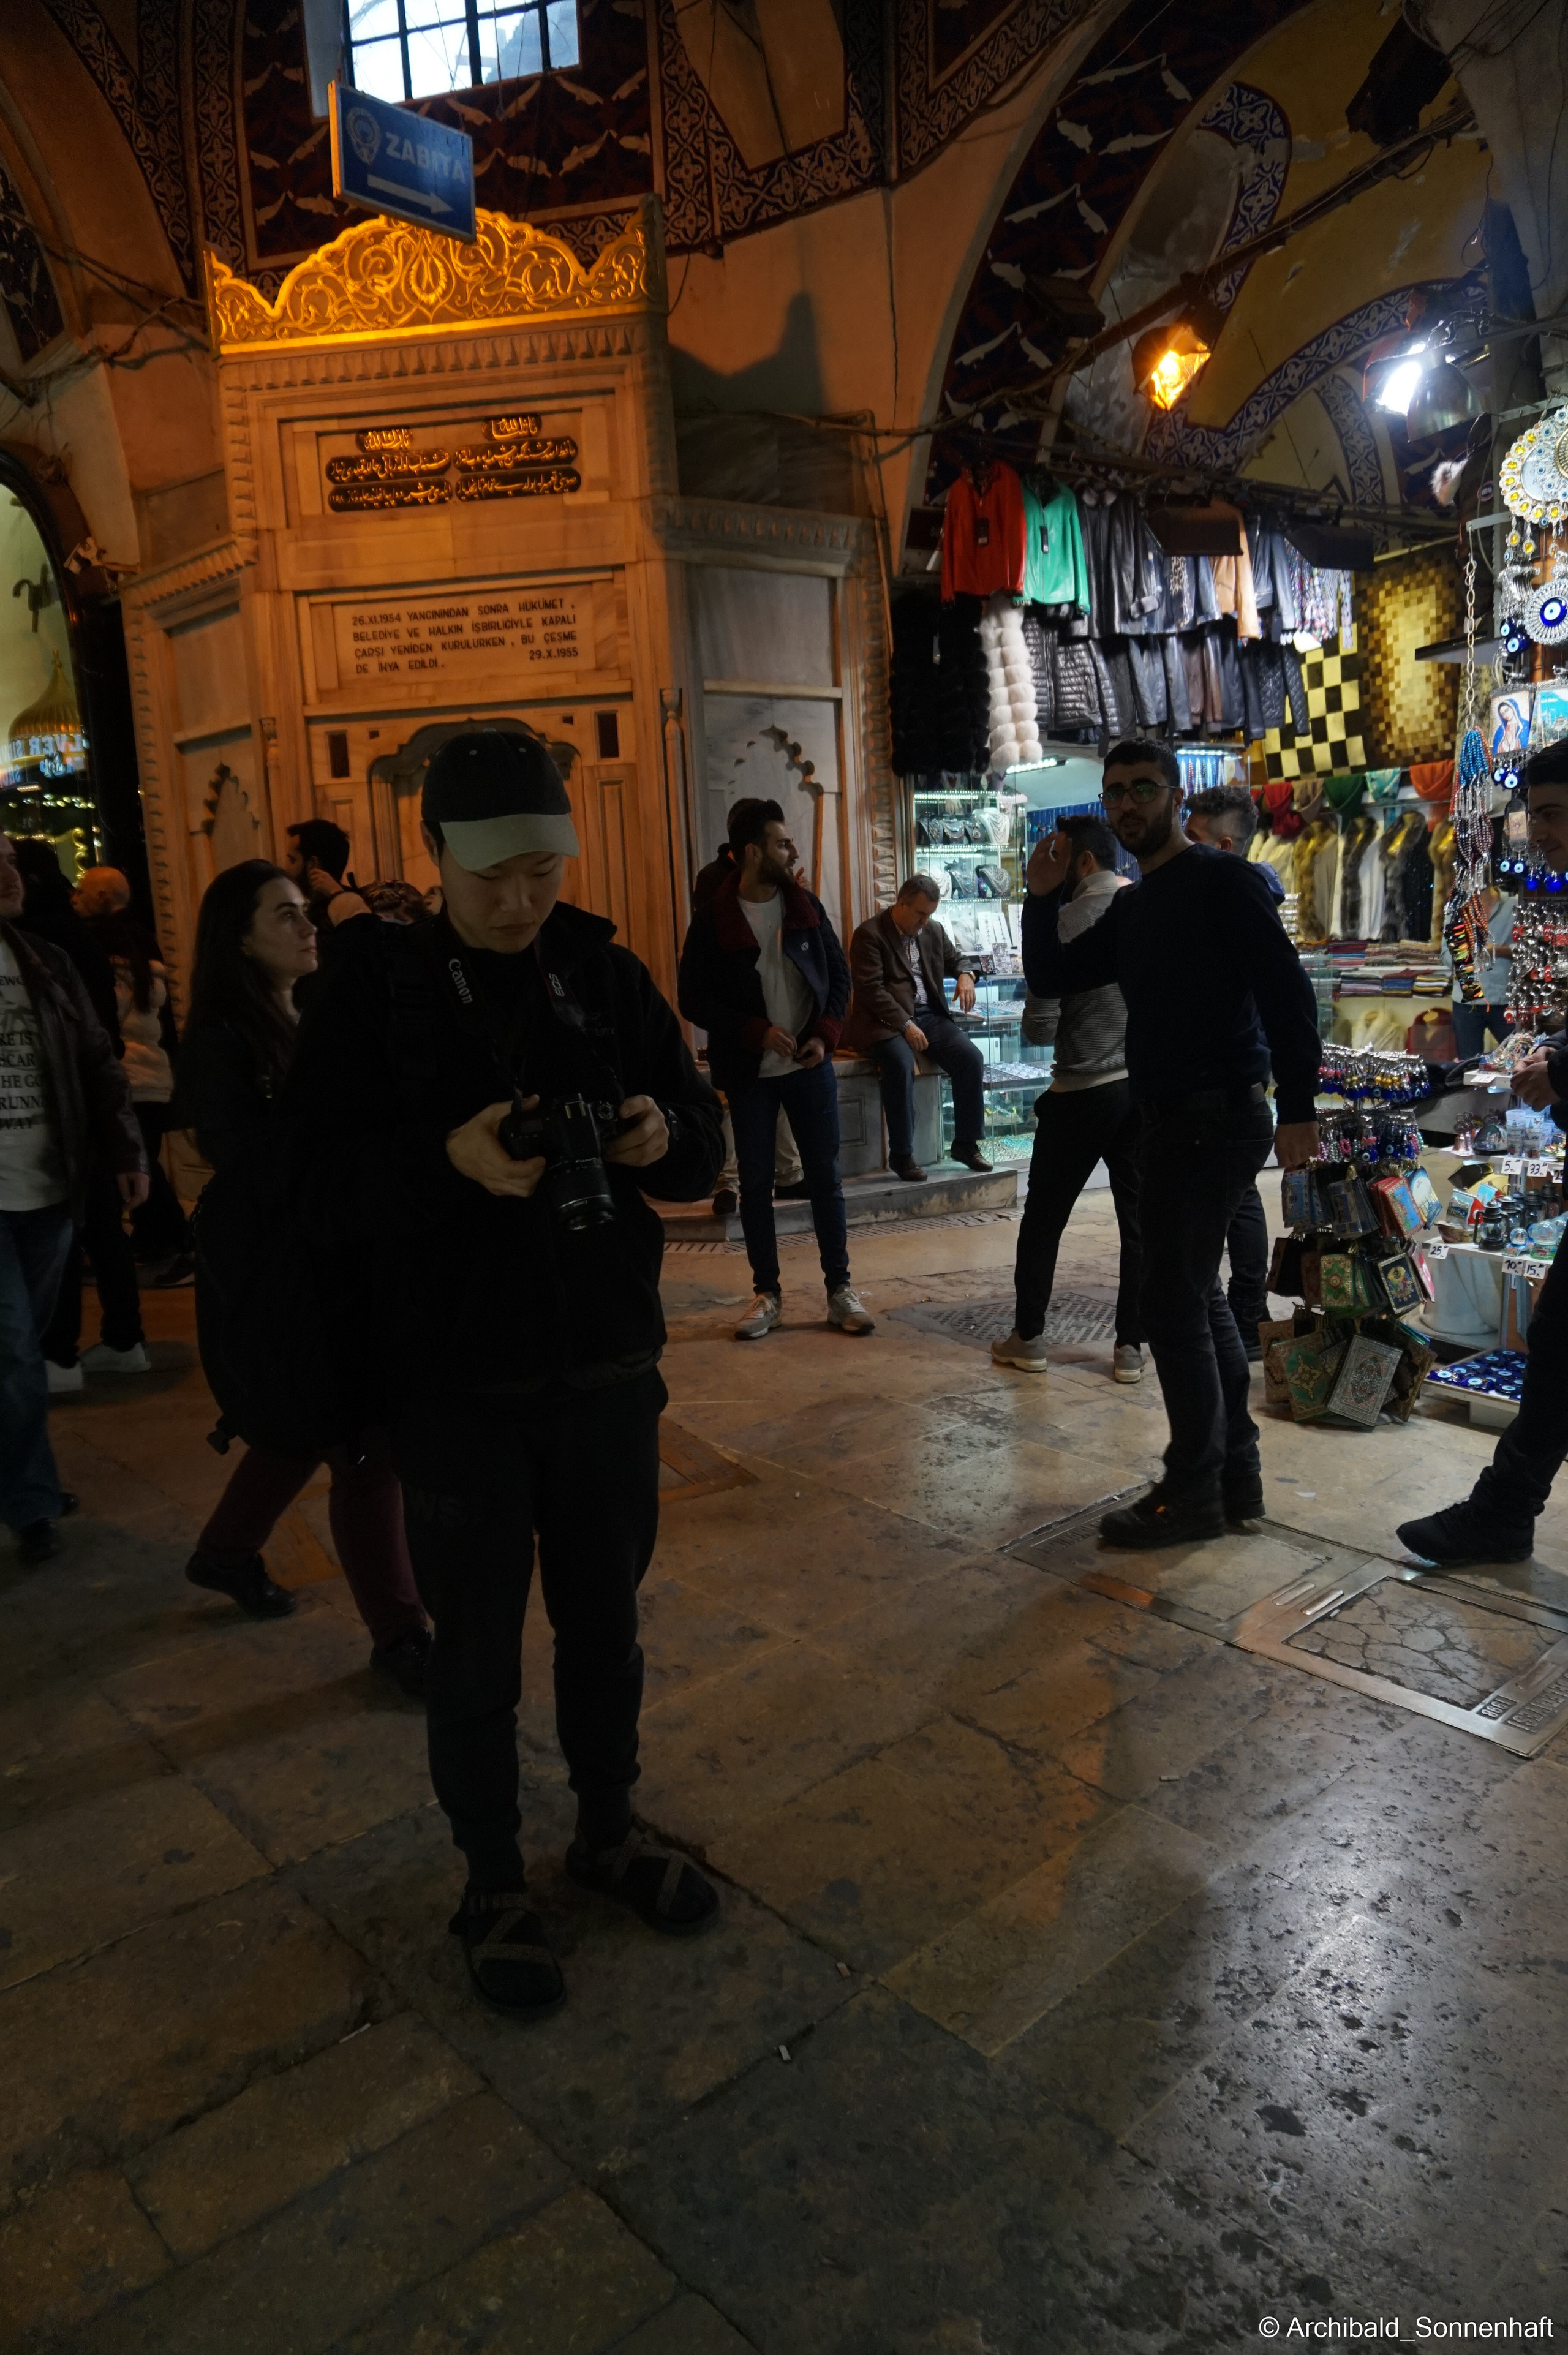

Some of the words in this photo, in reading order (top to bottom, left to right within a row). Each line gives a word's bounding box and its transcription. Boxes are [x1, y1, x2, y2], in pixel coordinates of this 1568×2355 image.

[385, 131, 465, 182] ZABITA
[478, 603, 509, 615] SONRA
[353, 628, 400, 642] BELEDİYE
[406, 627, 420, 638] VE
[429, 624, 464, 636] HALKIN
[541, 614, 576, 626] KAPALI
[355, 647, 384, 660] ÇARŞI
[391, 642, 432, 655] YENİDEN
[521, 634, 535, 644] BU
[543, 631, 576, 644] ÇEŞME
[356, 663, 369, 674] DE
[378, 661, 399, 673] İHYA
[529, 647, 578, 660] 29.X.1955
[448, 957, 473, 1004] Canon
[548, 973, 565, 997] EOS
[1430, 1246, 1442, 1256] 25
[1526, 1264, 1537, 1275] 15
